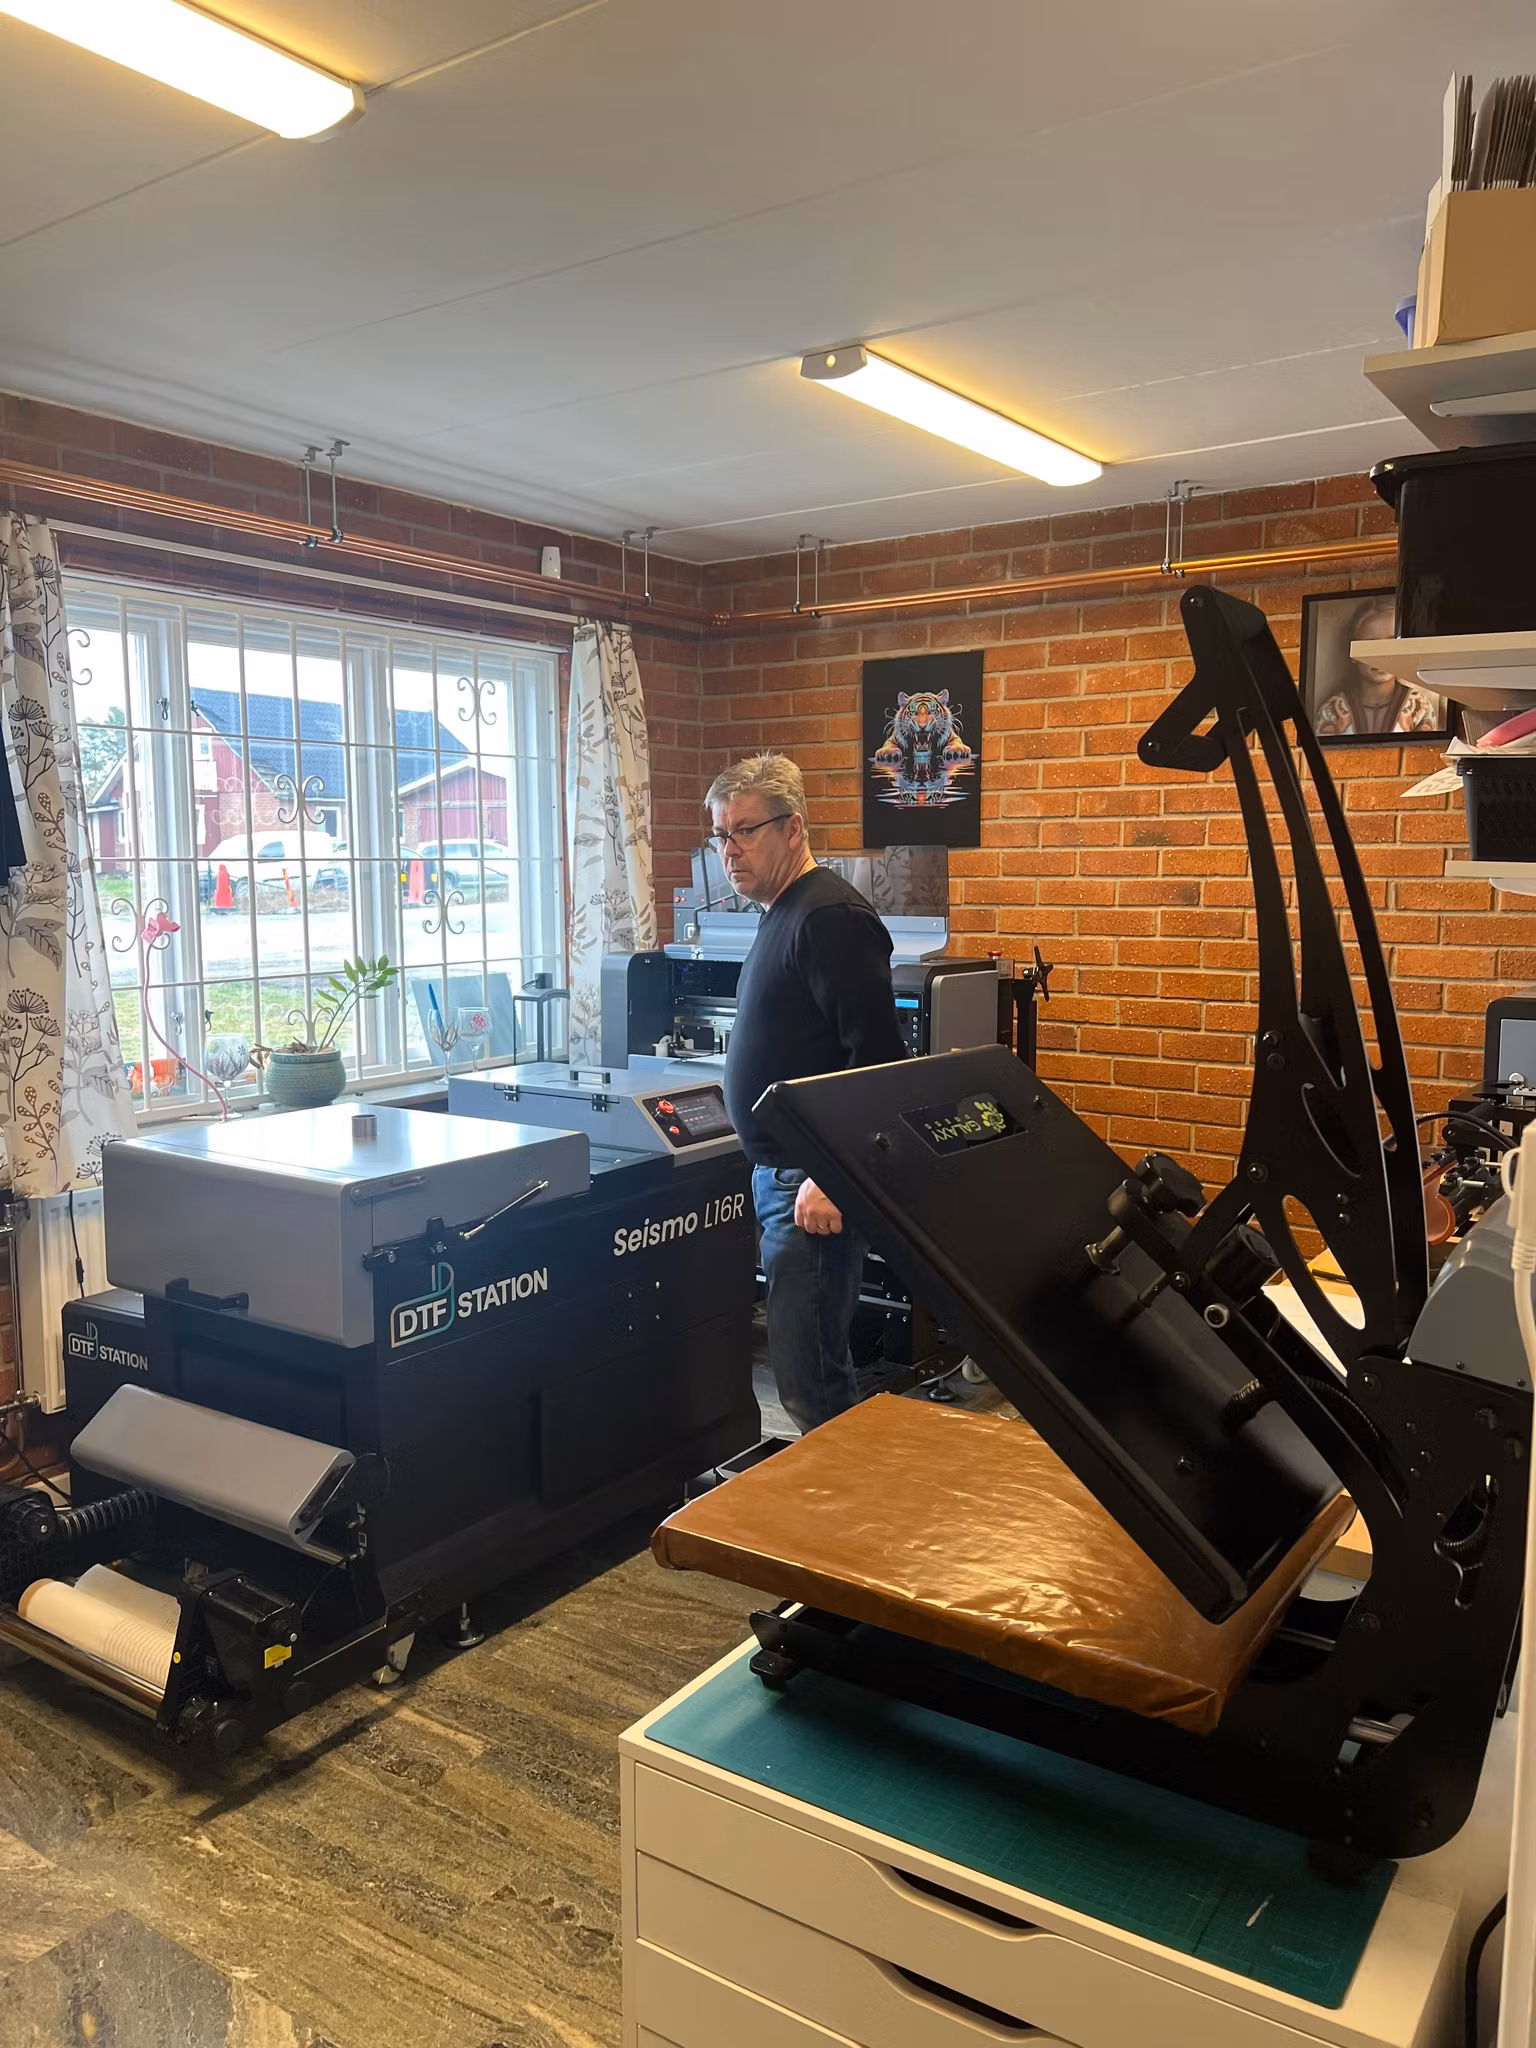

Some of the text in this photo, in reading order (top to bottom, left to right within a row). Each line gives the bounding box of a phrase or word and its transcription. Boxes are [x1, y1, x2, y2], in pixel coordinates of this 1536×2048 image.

[931, 1120, 982, 1143] GALAXY
[613, 1193, 745, 1257] Seismo L16R
[399, 1267, 549, 1338] DTF STATION
[71, 1337, 149, 1371] DTF STATION
